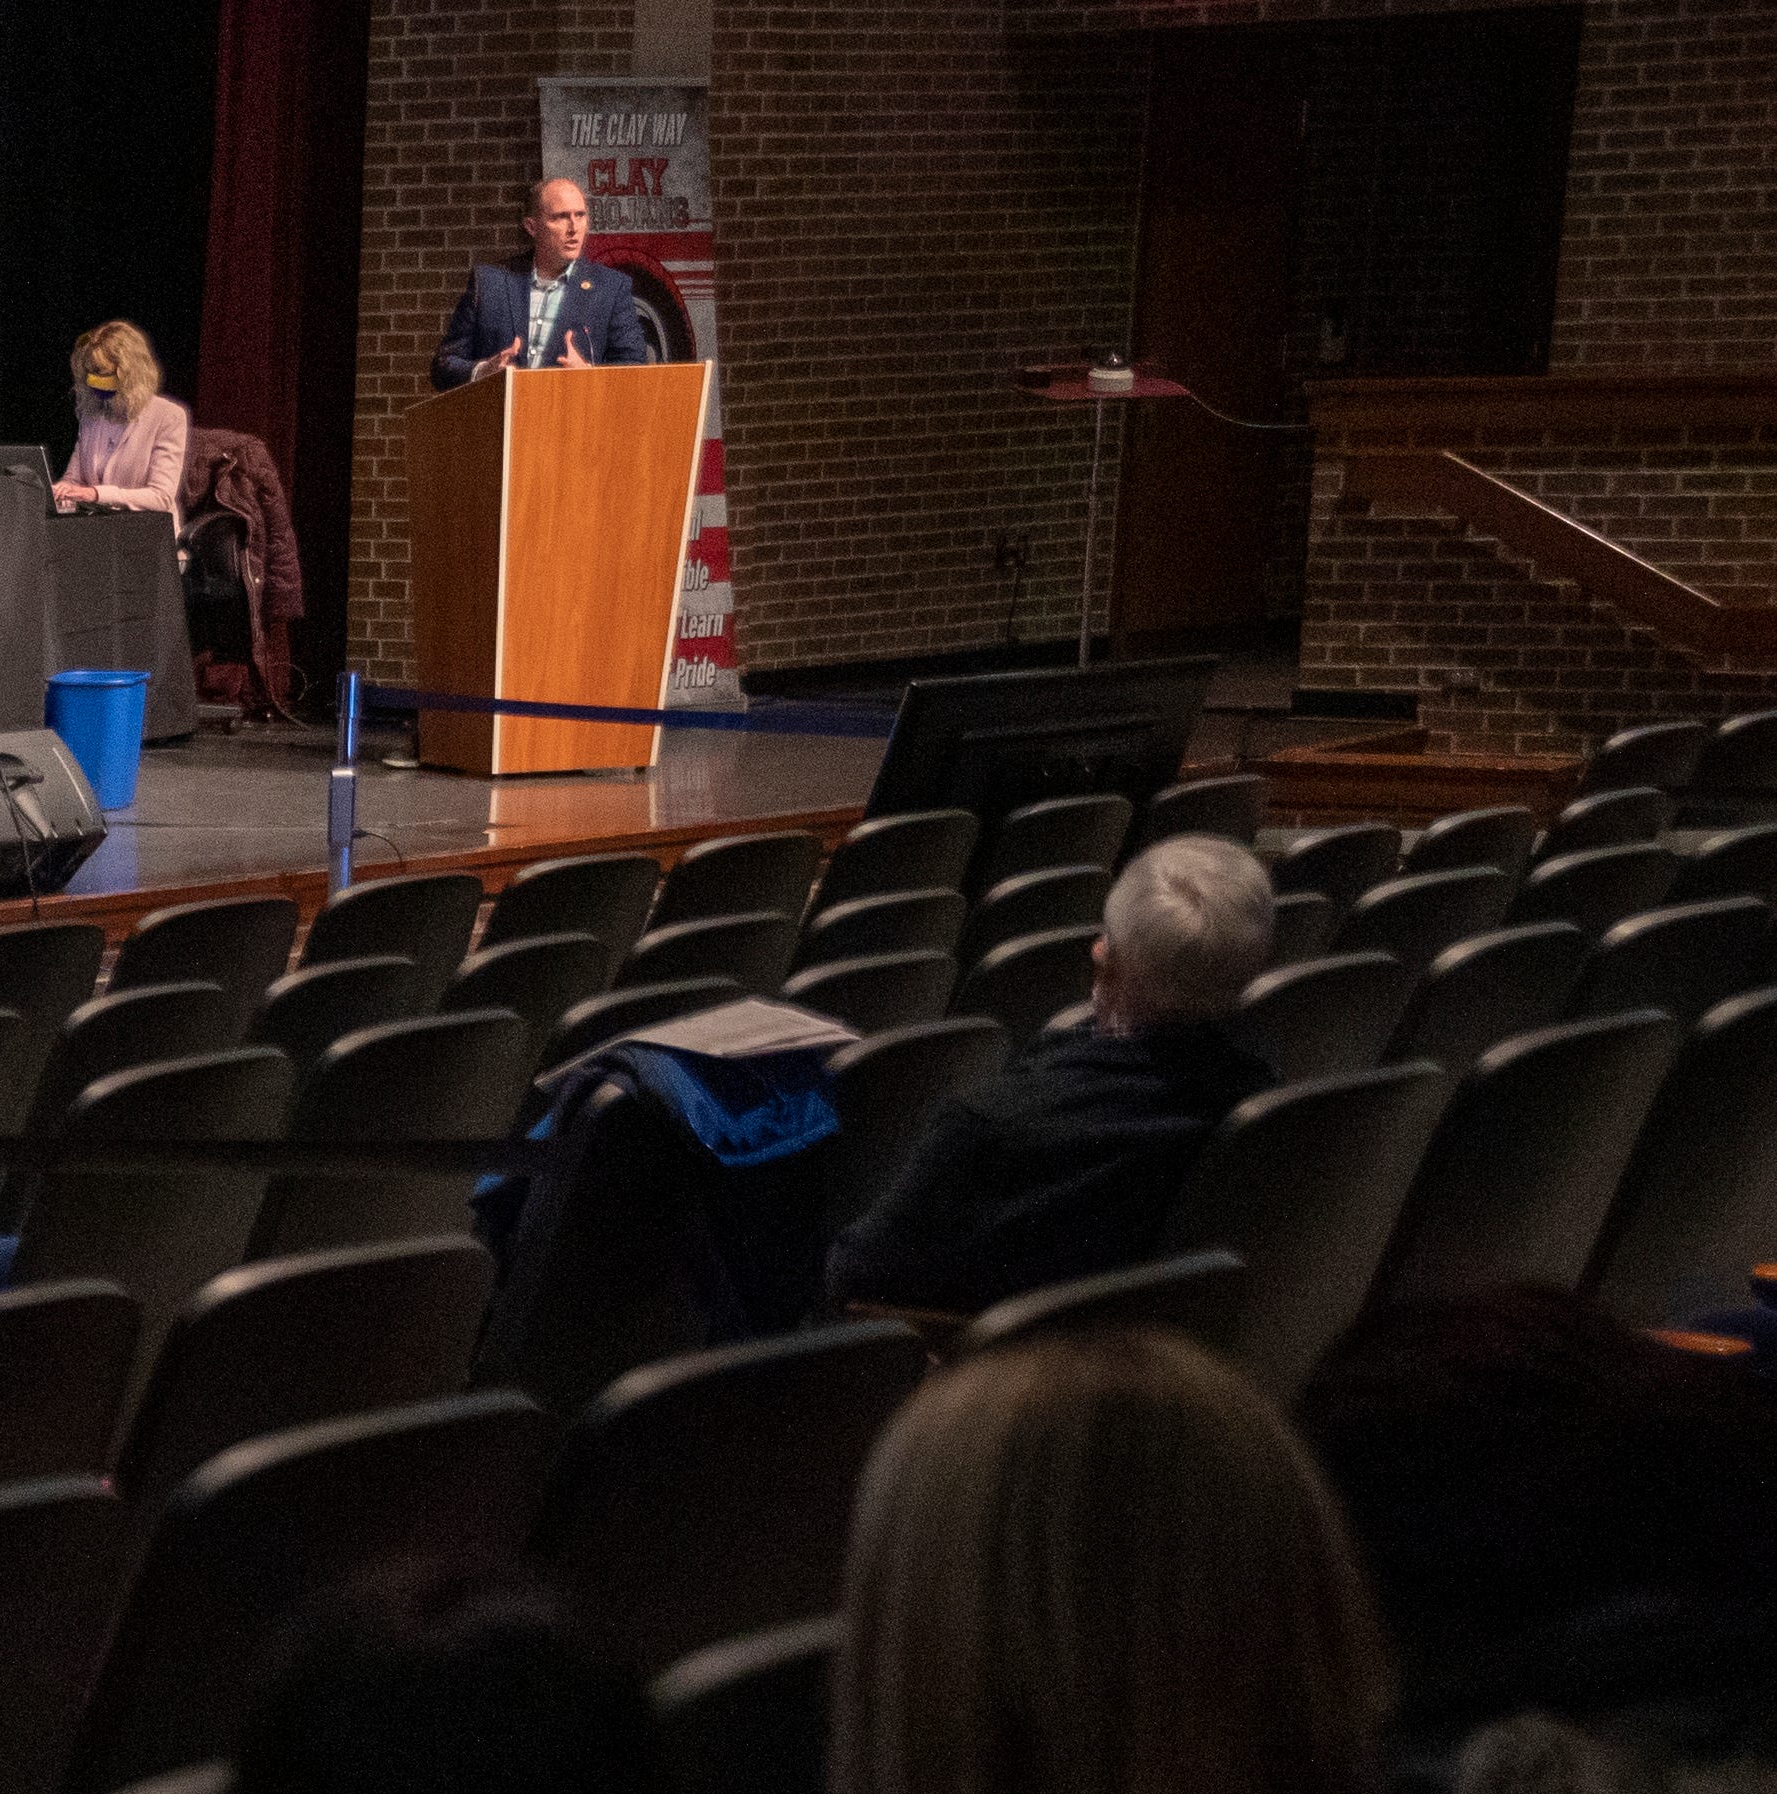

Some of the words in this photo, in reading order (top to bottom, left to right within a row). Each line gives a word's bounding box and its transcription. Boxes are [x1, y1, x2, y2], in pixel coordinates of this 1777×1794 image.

[571, 113, 603, 147] THE
[606, 113, 647, 146] CLAY
[652, 113, 687, 145] WAY
[587, 158, 669, 196] CLAY
[588, 196, 690, 230] ROJANS
[680, 609, 724, 639] Learn
[675, 656, 716, 689] Pride
